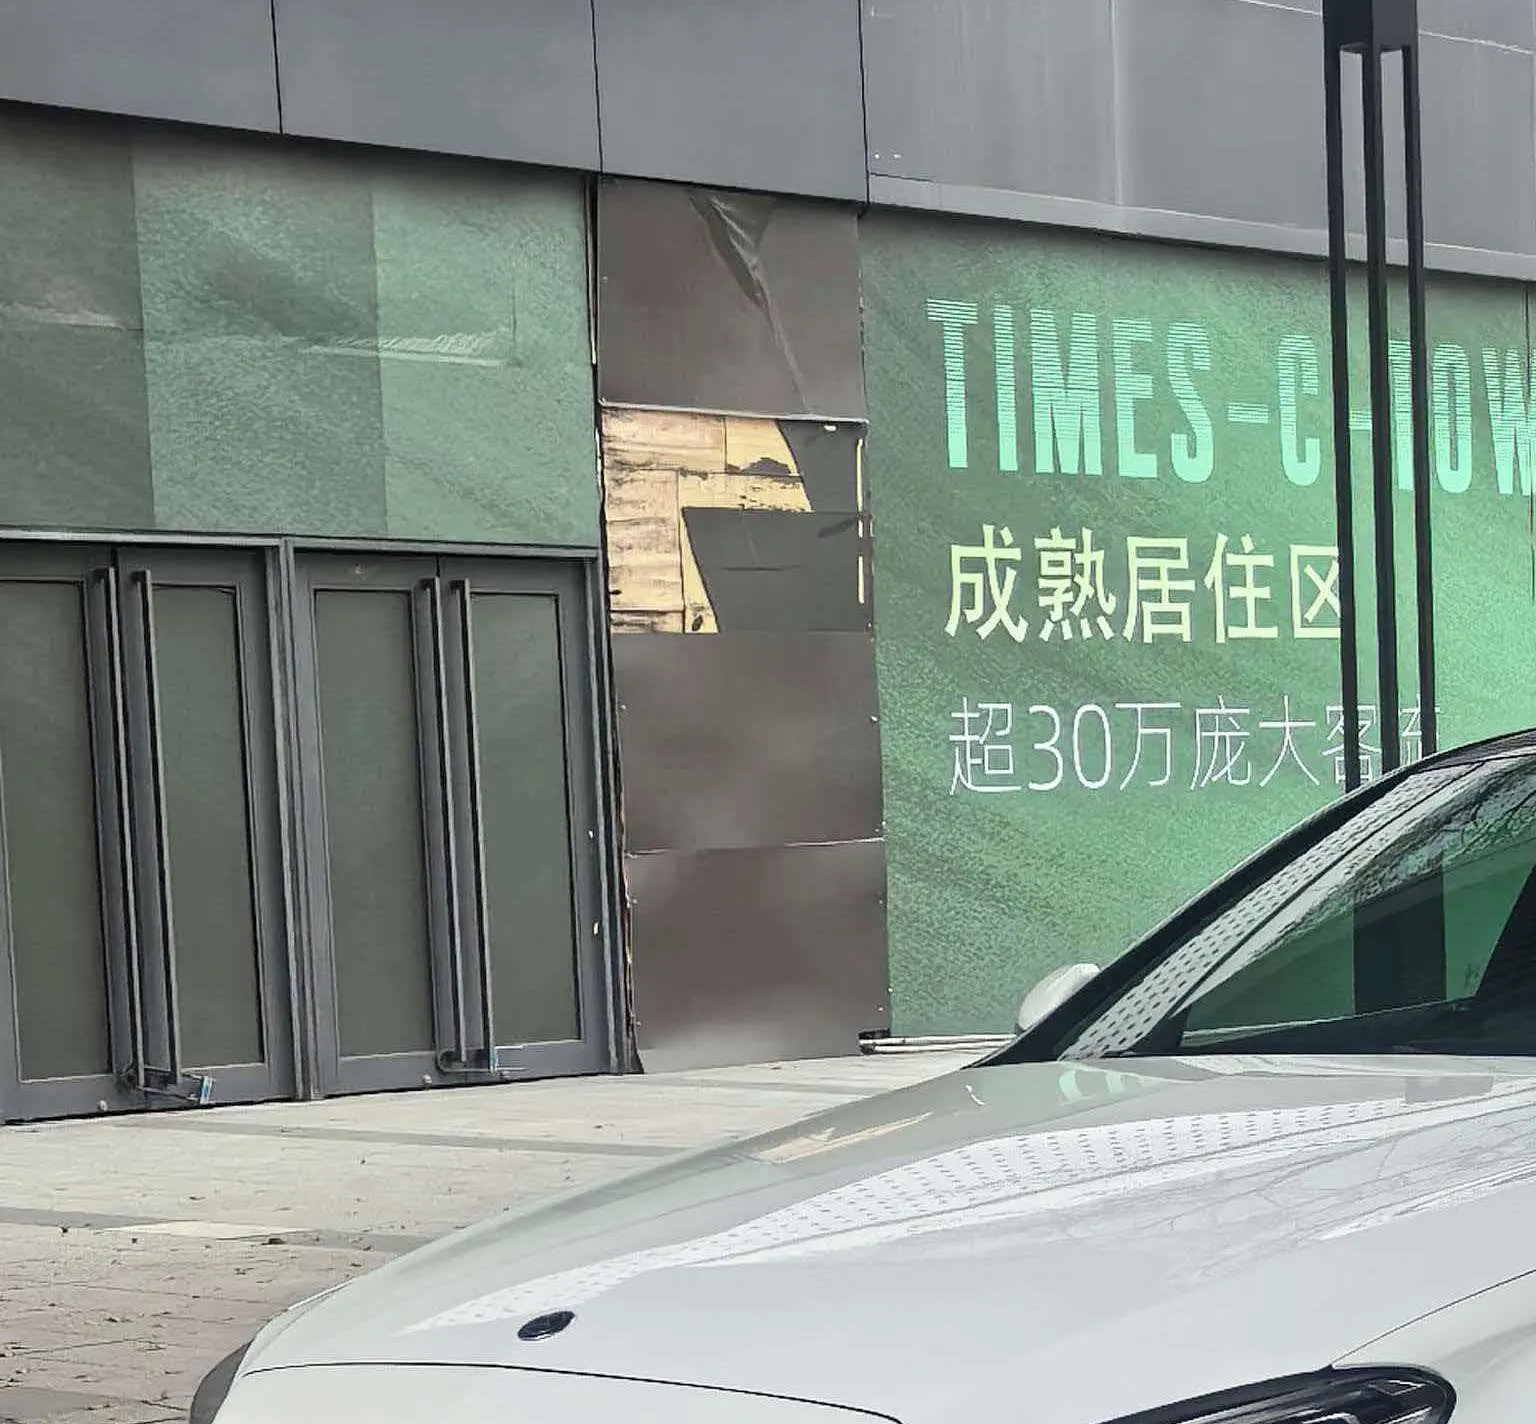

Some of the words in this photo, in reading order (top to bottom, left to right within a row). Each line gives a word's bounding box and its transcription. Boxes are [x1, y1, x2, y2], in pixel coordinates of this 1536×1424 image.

[945, 524, 1343, 643] 成熟居住区
